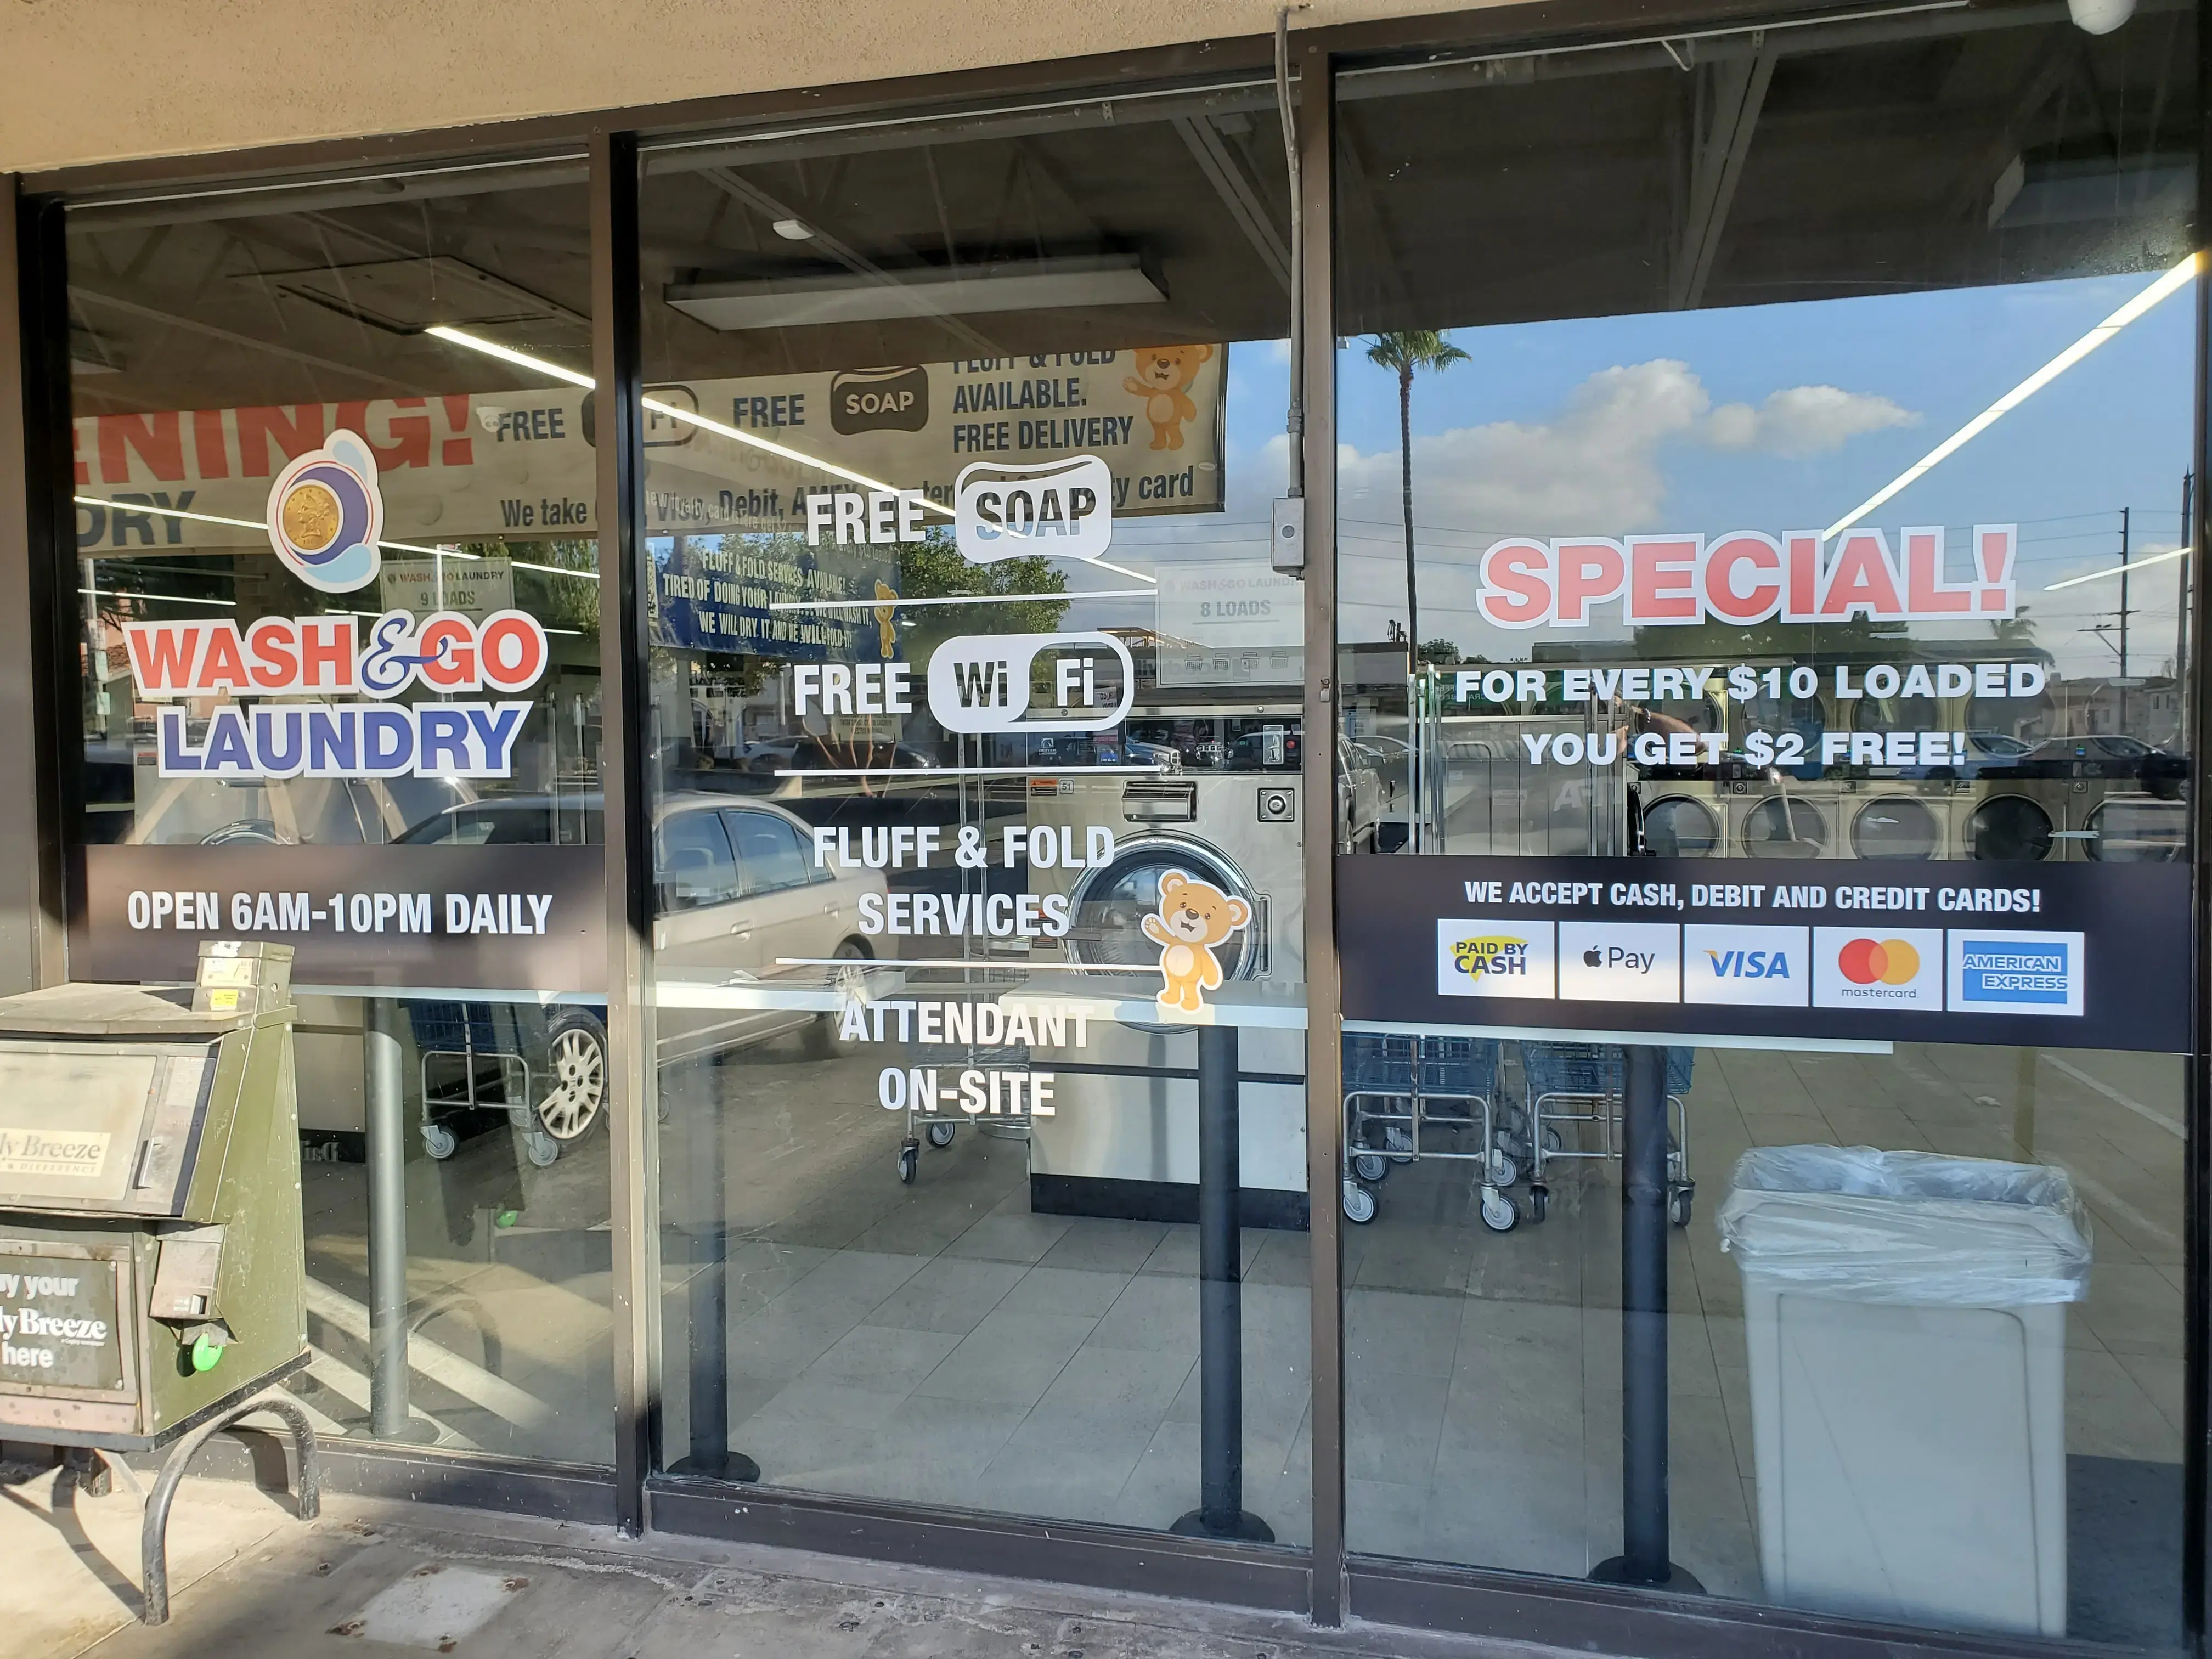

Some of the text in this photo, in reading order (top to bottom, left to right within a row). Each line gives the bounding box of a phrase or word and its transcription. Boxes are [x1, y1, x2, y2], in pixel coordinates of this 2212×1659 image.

[845, 390, 914, 415] SOAP
[953, 378, 1087, 413] AVAILABLE.
[496, 408, 565, 441] FREE
[733, 394, 805, 429] FREE
[953, 416, 1134, 453] FREE DELIVERY
[72, 393, 473, 485] NING!
[500, 500, 533, 527] We
[540, 498, 588, 525] take
[719, 488, 783, 520] Debit,
[1139, 466, 1194, 500] card
[975, 487, 1096, 540] SOAP
[808, 489, 926, 546] FREE
[456, 571, 504, 581] LAUNDRY
[702, 548, 733, 573] FLUFF
[742, 556, 765, 579] FOLD
[1481, 531, 2009, 625] SPECIAL!
[421, 592, 428, 606] 9
[663, 573, 695, 599] TIRED
[697, 579, 710, 602] OF
[714, 581, 740, 606] DOING
[741, 585, 768, 610] YOUR
[1200, 600, 1271, 617] 8 LOADS
[699, 611, 716, 634] WE
[719, 613, 738, 636] WILL
[761, 618, 770, 639] IT
[794, 663, 912, 715] FREE
[1456, 663, 2045, 704] FOR EVERY $10 LOADED
[163, 709, 522, 772] LAUNDRY
[1520, 729, 1965, 770] YOU GET $2 FREE!
[814, 826, 1114, 868] FLUFF & FOLD
[128, 891, 552, 935] OPEN 6AM-10PM DAILY
[1465, 881, 2041, 913] WE ACCEPT CASH, DEBIT AND CREDIT CARDS!
[859, 893, 1069, 937] SERVICES
[1453, 956, 1527, 976] CASH
[1455, 941, 1528, 957] PAID BY
[1608, 947, 1655, 974] Pay
[1703, 949, 1790, 979] VISA
[1962, 953, 2061, 972] AMERICAN
[1982, 973, 2068, 991] EXPRESS
[839, 1001, 1094, 1047] ATTENDANT
[878, 1069, 1056, 1116] ON-SITE
[20, 1134, 101, 1159] Breeze
[24, 1276, 80, 1300] your
[18, 1308, 108, 1339] Breeze
[1, 1341, 54, 1368] here
